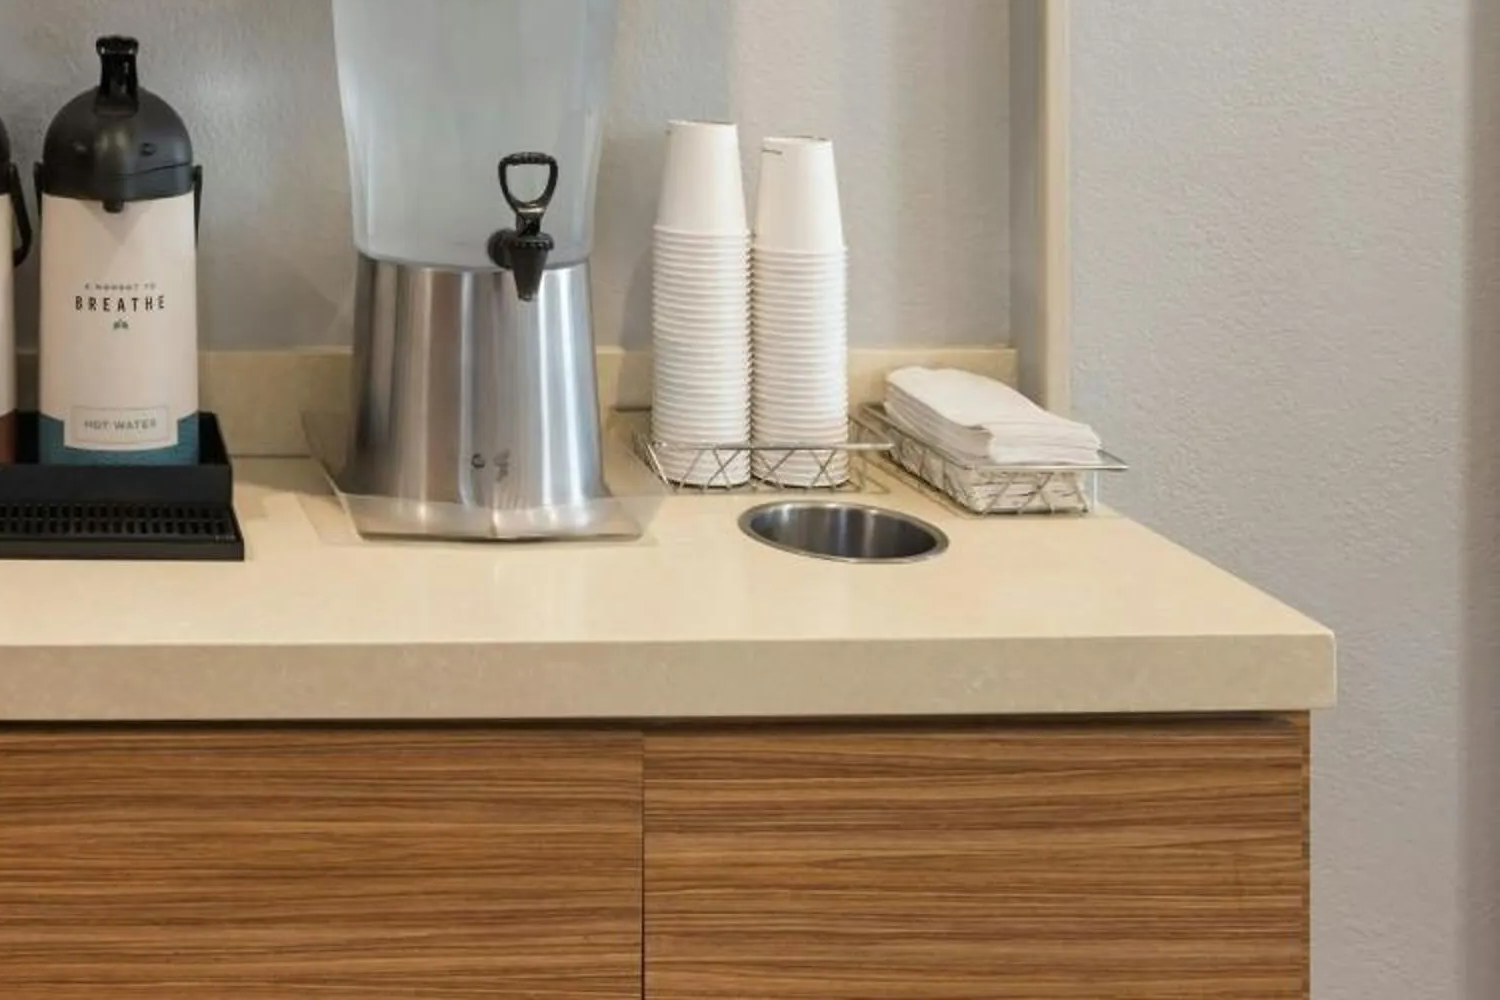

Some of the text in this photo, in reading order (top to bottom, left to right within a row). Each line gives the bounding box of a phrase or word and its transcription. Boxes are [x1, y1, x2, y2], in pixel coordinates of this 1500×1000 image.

[75, 295, 165, 312] BREATHE
[84, 417, 157, 430] HOT WATER
